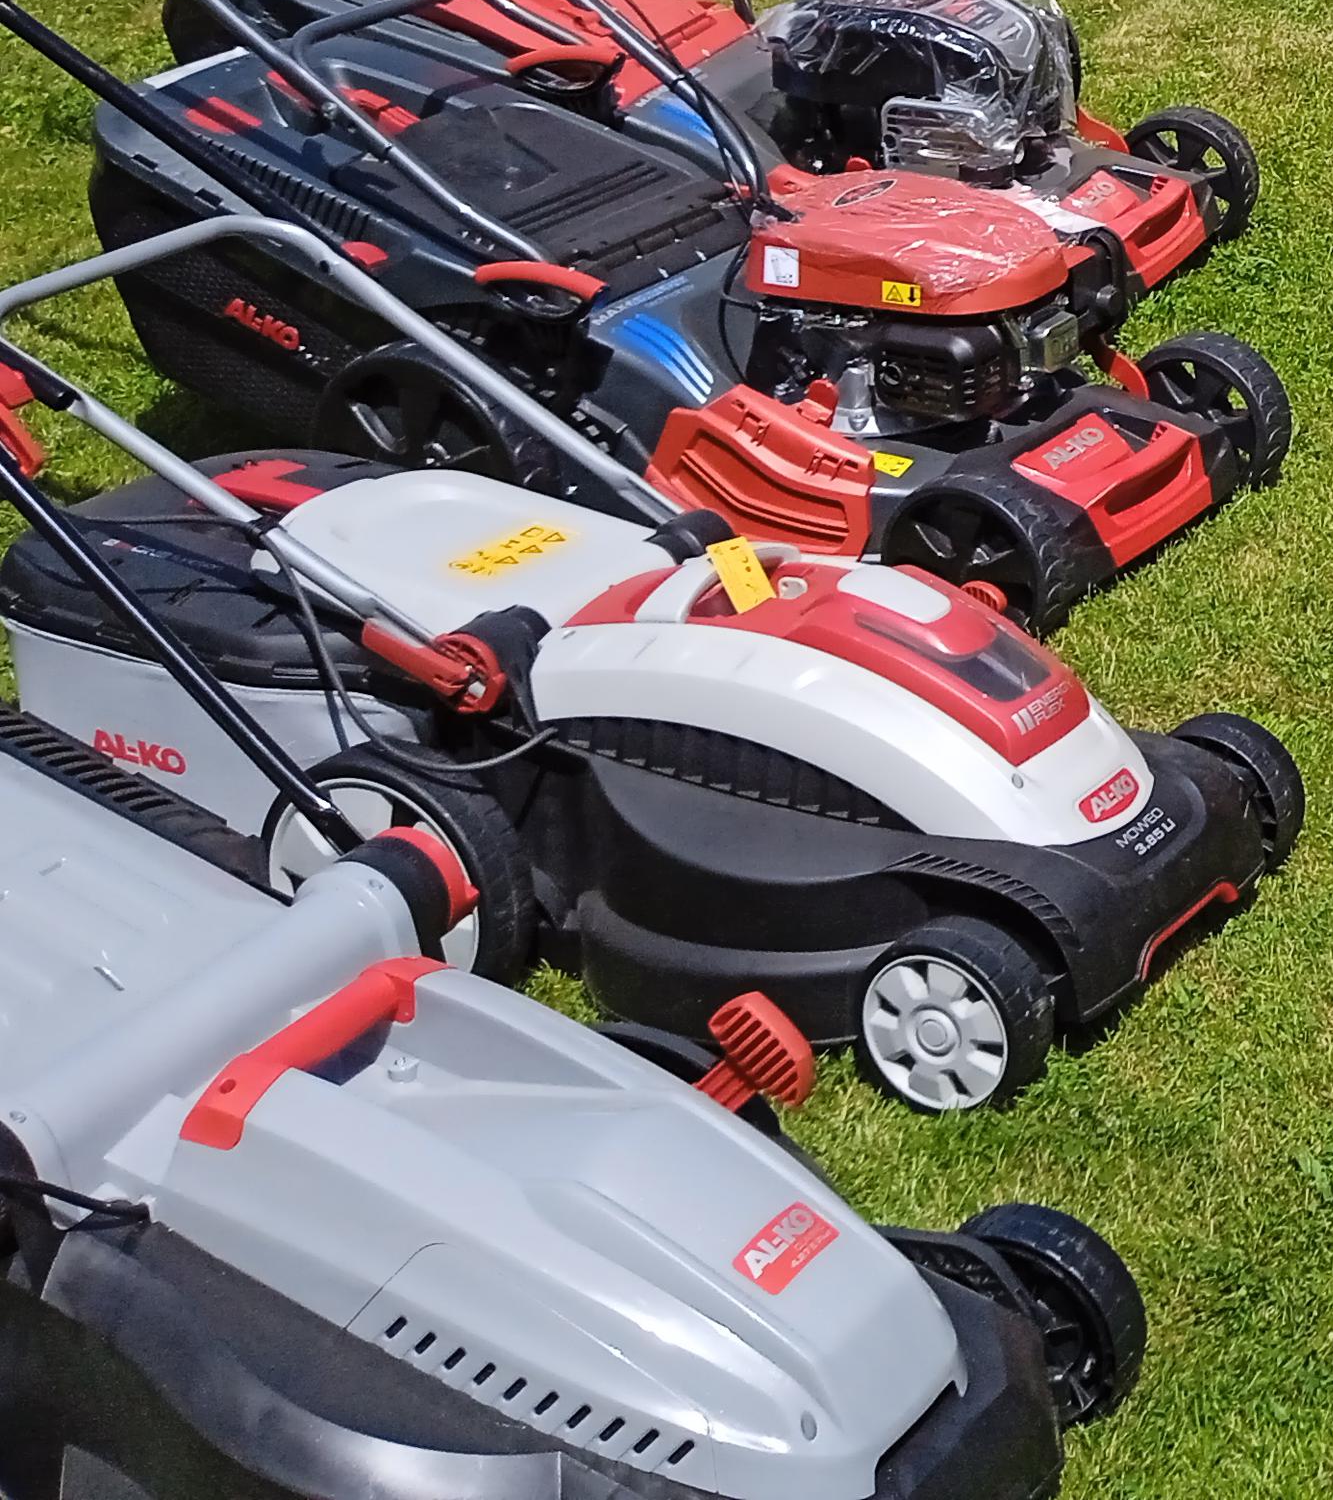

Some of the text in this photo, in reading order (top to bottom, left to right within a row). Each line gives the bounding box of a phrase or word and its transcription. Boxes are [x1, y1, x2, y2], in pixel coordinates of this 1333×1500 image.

[224, 298, 300, 350] AL-KO
[95, 728, 186, 775] AL-KO
[1134, 828, 1164, 856] 3.85
[743, 1208, 815, 1280] AL-KO
